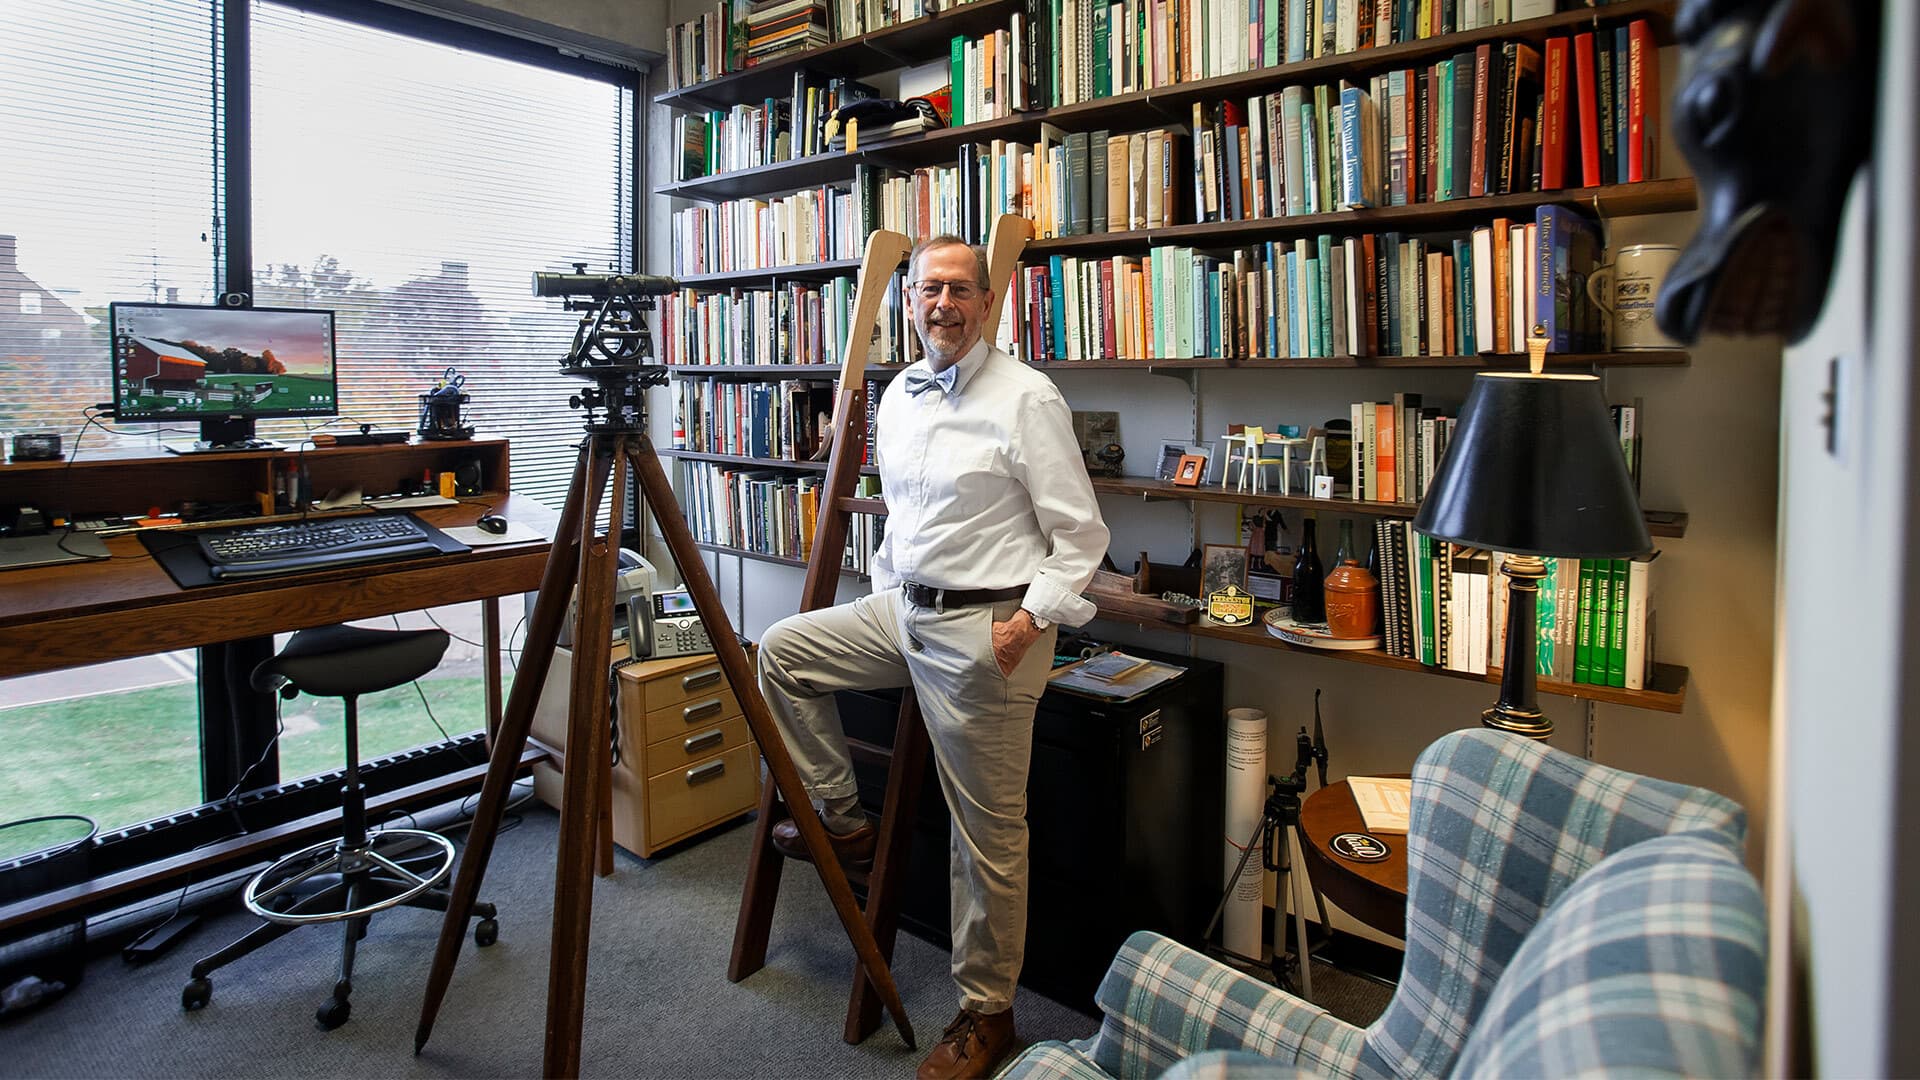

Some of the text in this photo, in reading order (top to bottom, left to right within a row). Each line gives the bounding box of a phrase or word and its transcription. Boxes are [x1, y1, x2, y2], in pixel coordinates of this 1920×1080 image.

[1343, 100, 1357, 191] Tidewater Towns
[1503, 118, 1511, 142] Northern
[1539, 215, 1552, 296] Atlas of Kentucky
[1379, 256, 1389, 330] TWO CARPENTERS
[1431, 274, 1440, 310] American
[866, 381, 875, 464] ROCHESTER
[1281, 631, 1314, 645] Schlitz
[1555, 620, 1563, 644] Campaign
[1565, 621, 1574, 645] Campaign
